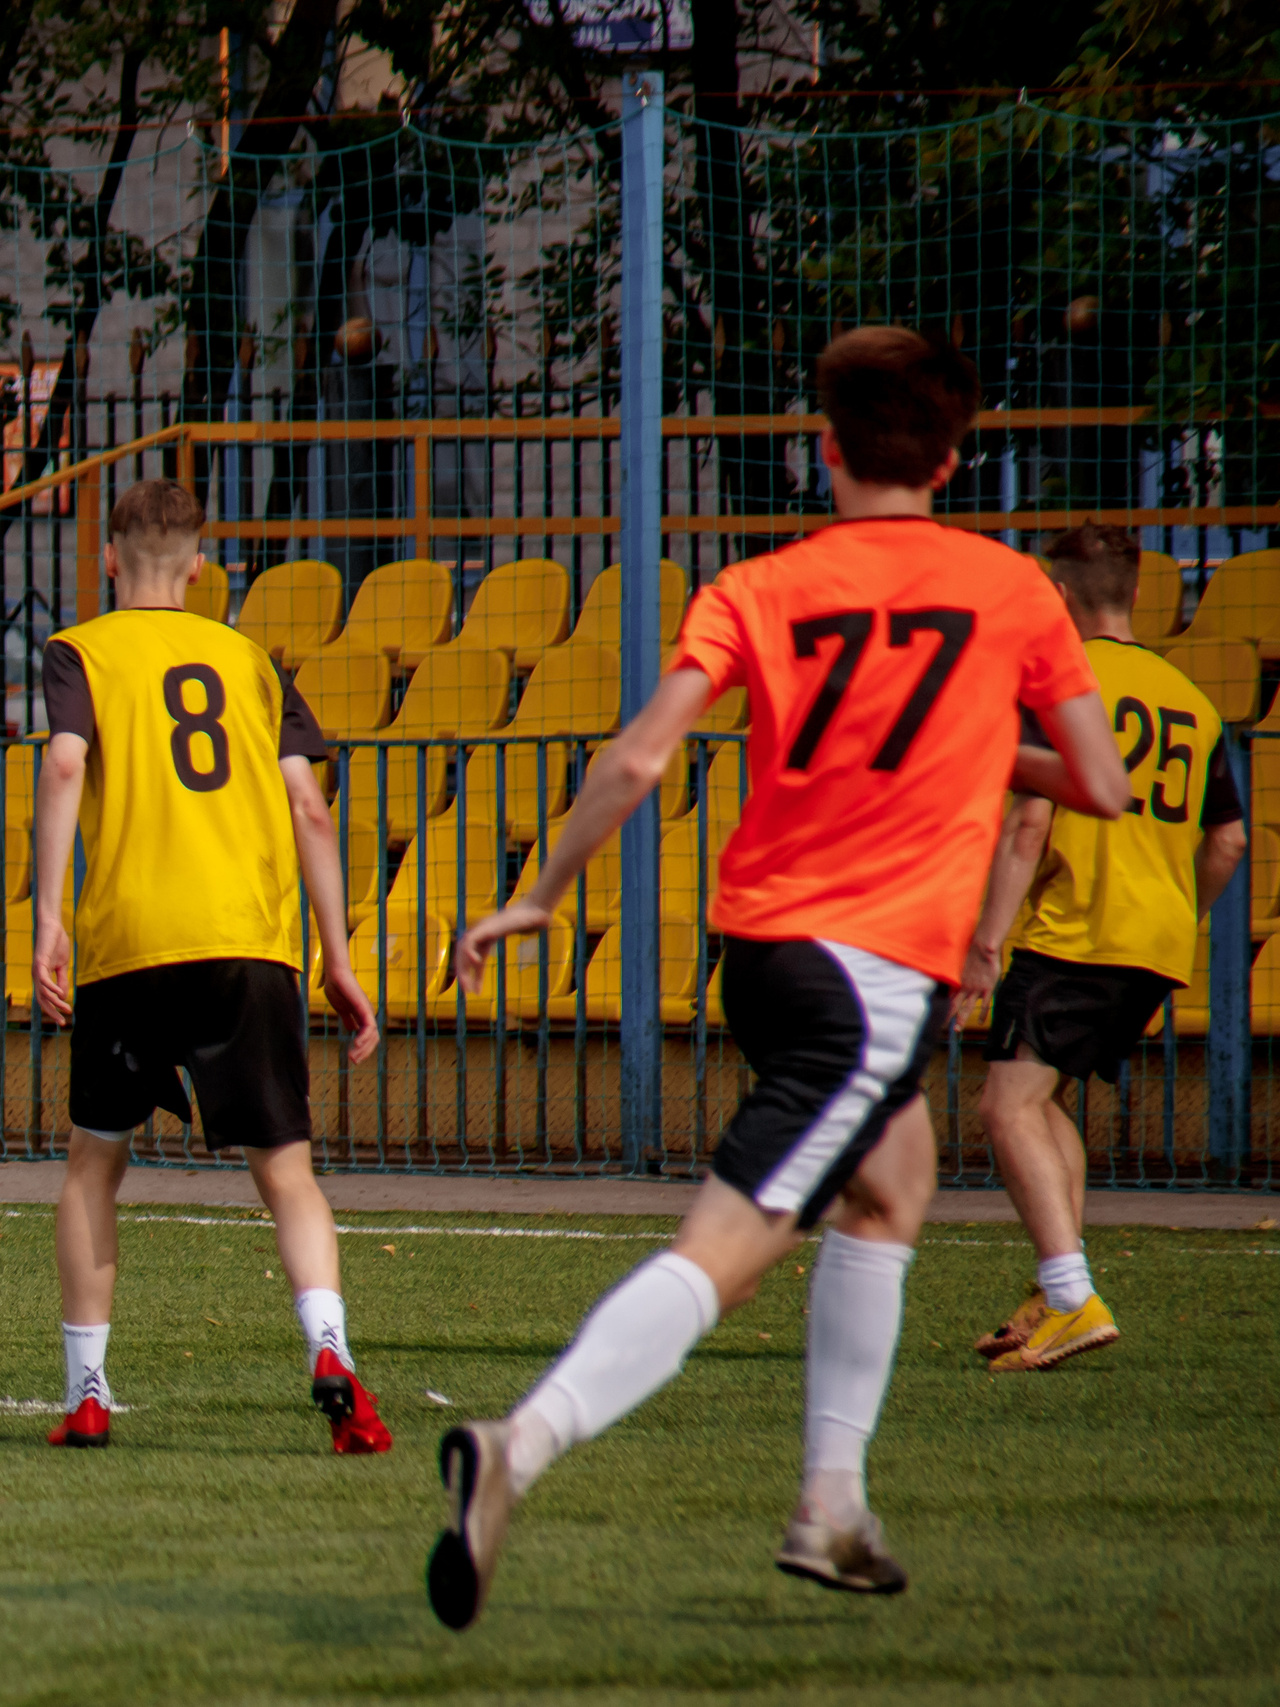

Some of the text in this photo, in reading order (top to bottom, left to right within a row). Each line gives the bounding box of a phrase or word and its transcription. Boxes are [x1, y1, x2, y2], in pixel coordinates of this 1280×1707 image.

[163, 663, 231, 793] 8
[786, 605, 976, 771] 77
[1115, 696, 1197, 824] 25
